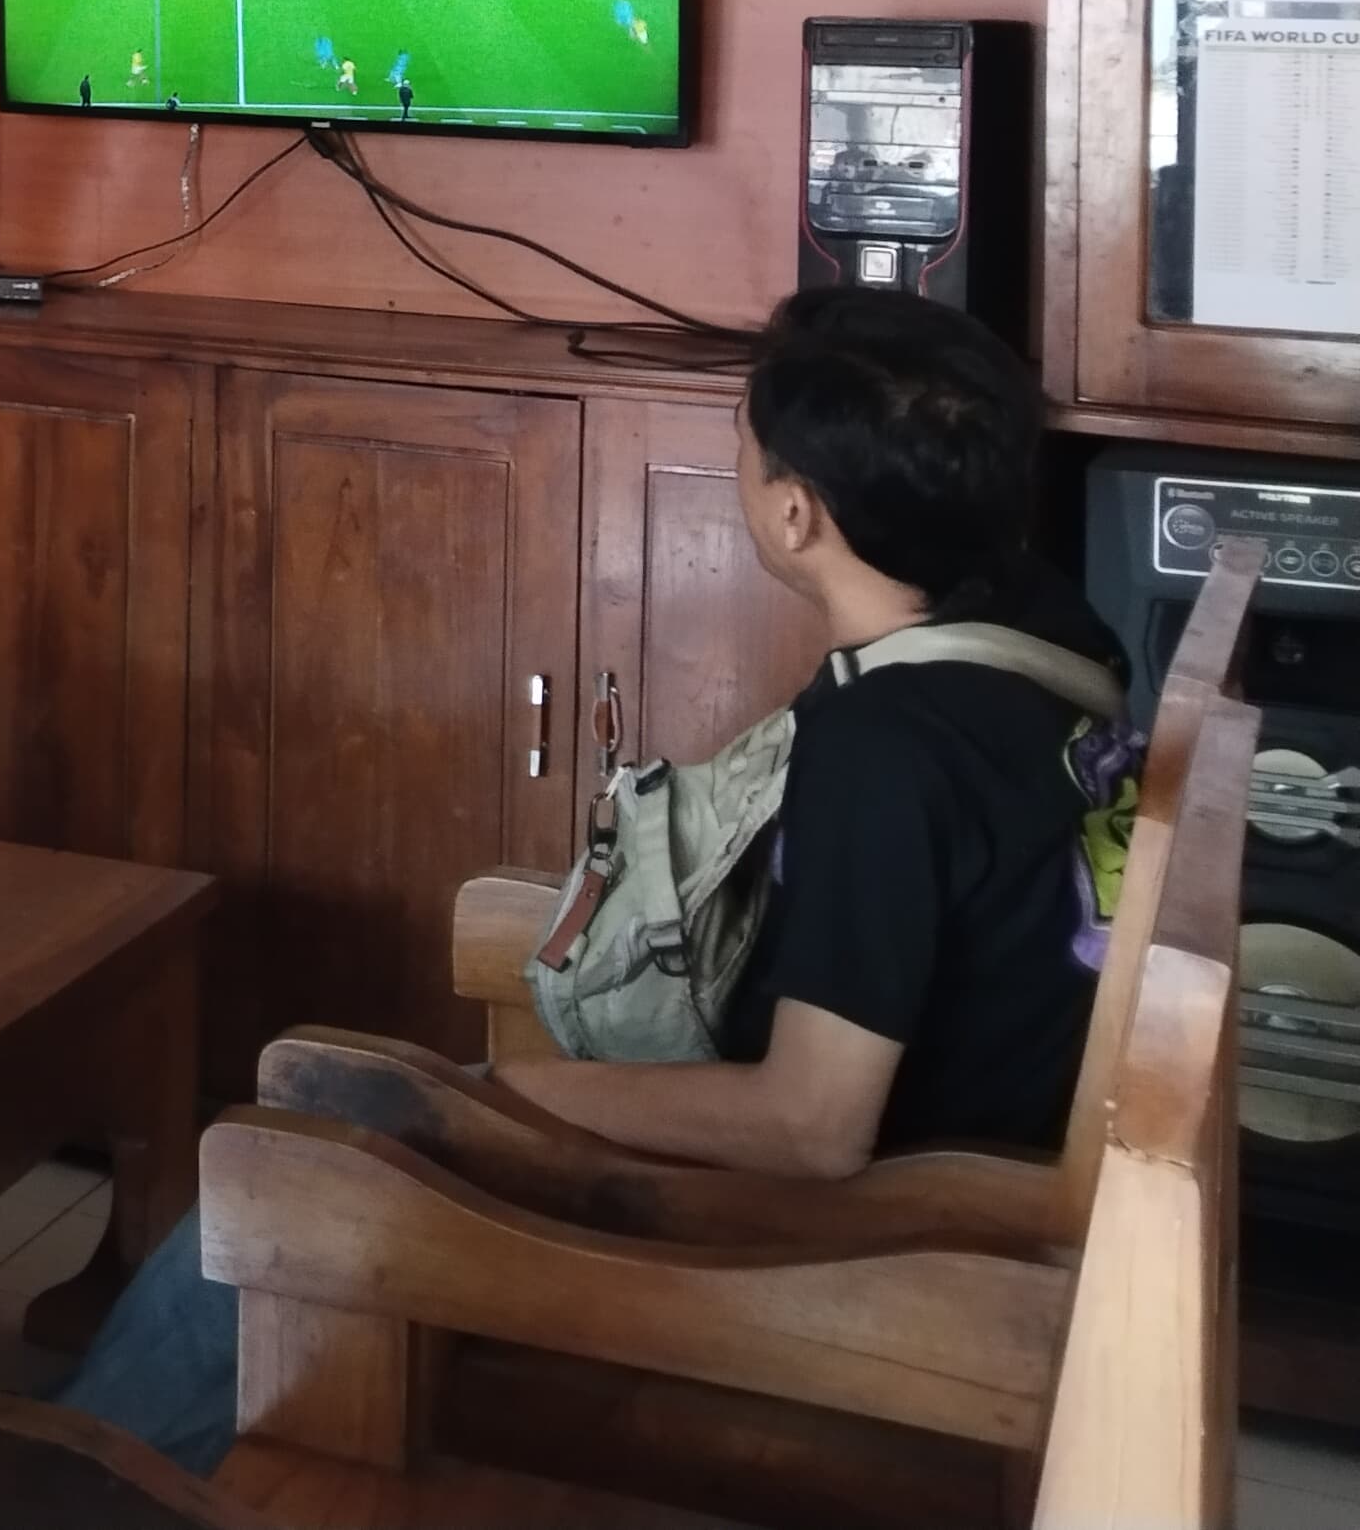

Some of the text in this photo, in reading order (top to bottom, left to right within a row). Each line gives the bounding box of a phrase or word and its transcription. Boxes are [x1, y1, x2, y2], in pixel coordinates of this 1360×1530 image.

[1204, 30, 1247, 42] FIFA
[1251, 31, 1327, 44] WORLD
[1230, 509, 1276, 522] ACTIVE
